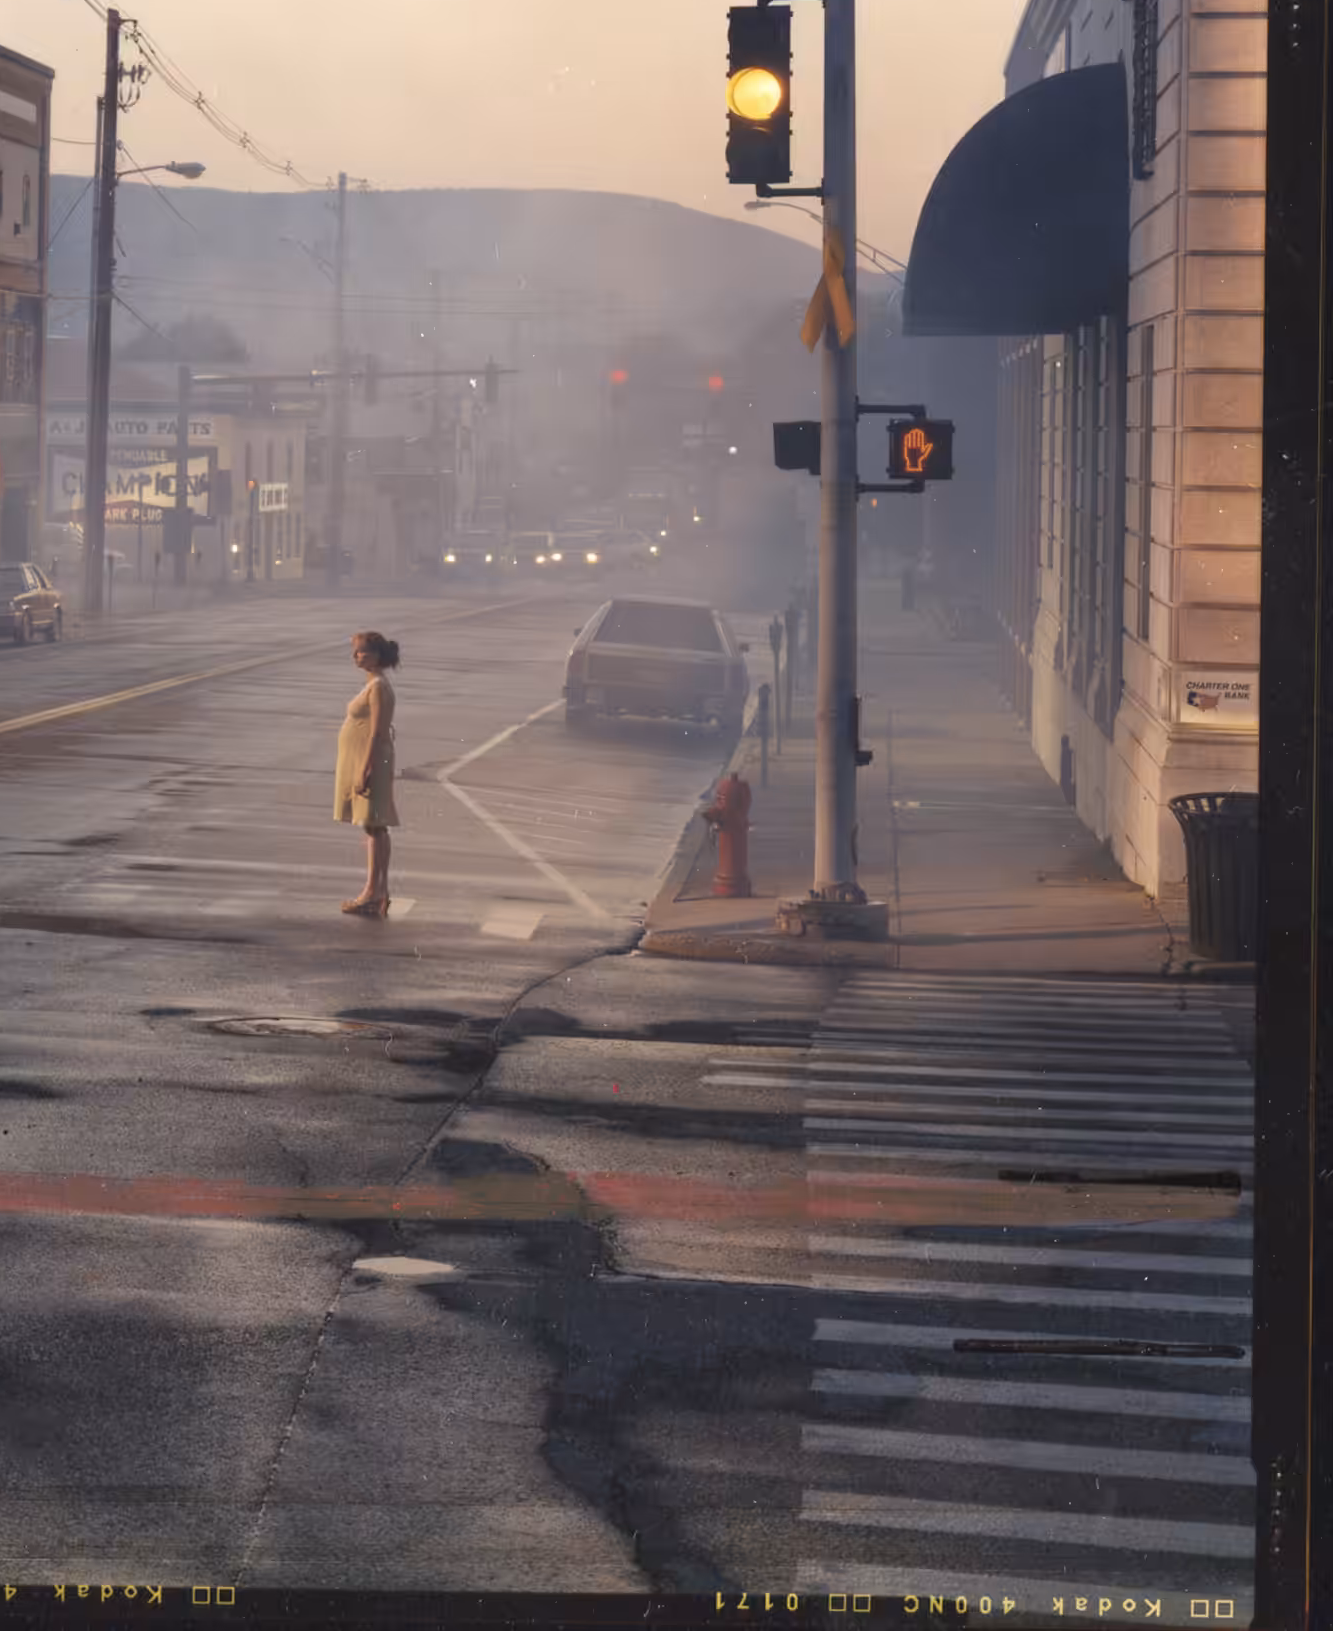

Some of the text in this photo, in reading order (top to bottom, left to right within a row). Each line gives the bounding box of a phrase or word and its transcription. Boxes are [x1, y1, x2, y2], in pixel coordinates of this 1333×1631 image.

[157, 421, 212, 435] PATS
[1186, 681, 1251, 691] CHARTER ONE
[1224, 691, 1250, 700] BANK
[55, 1584, 161, 1603] Kodak
[717, 1592, 1161, 1617] Kodak 400NC 0171
